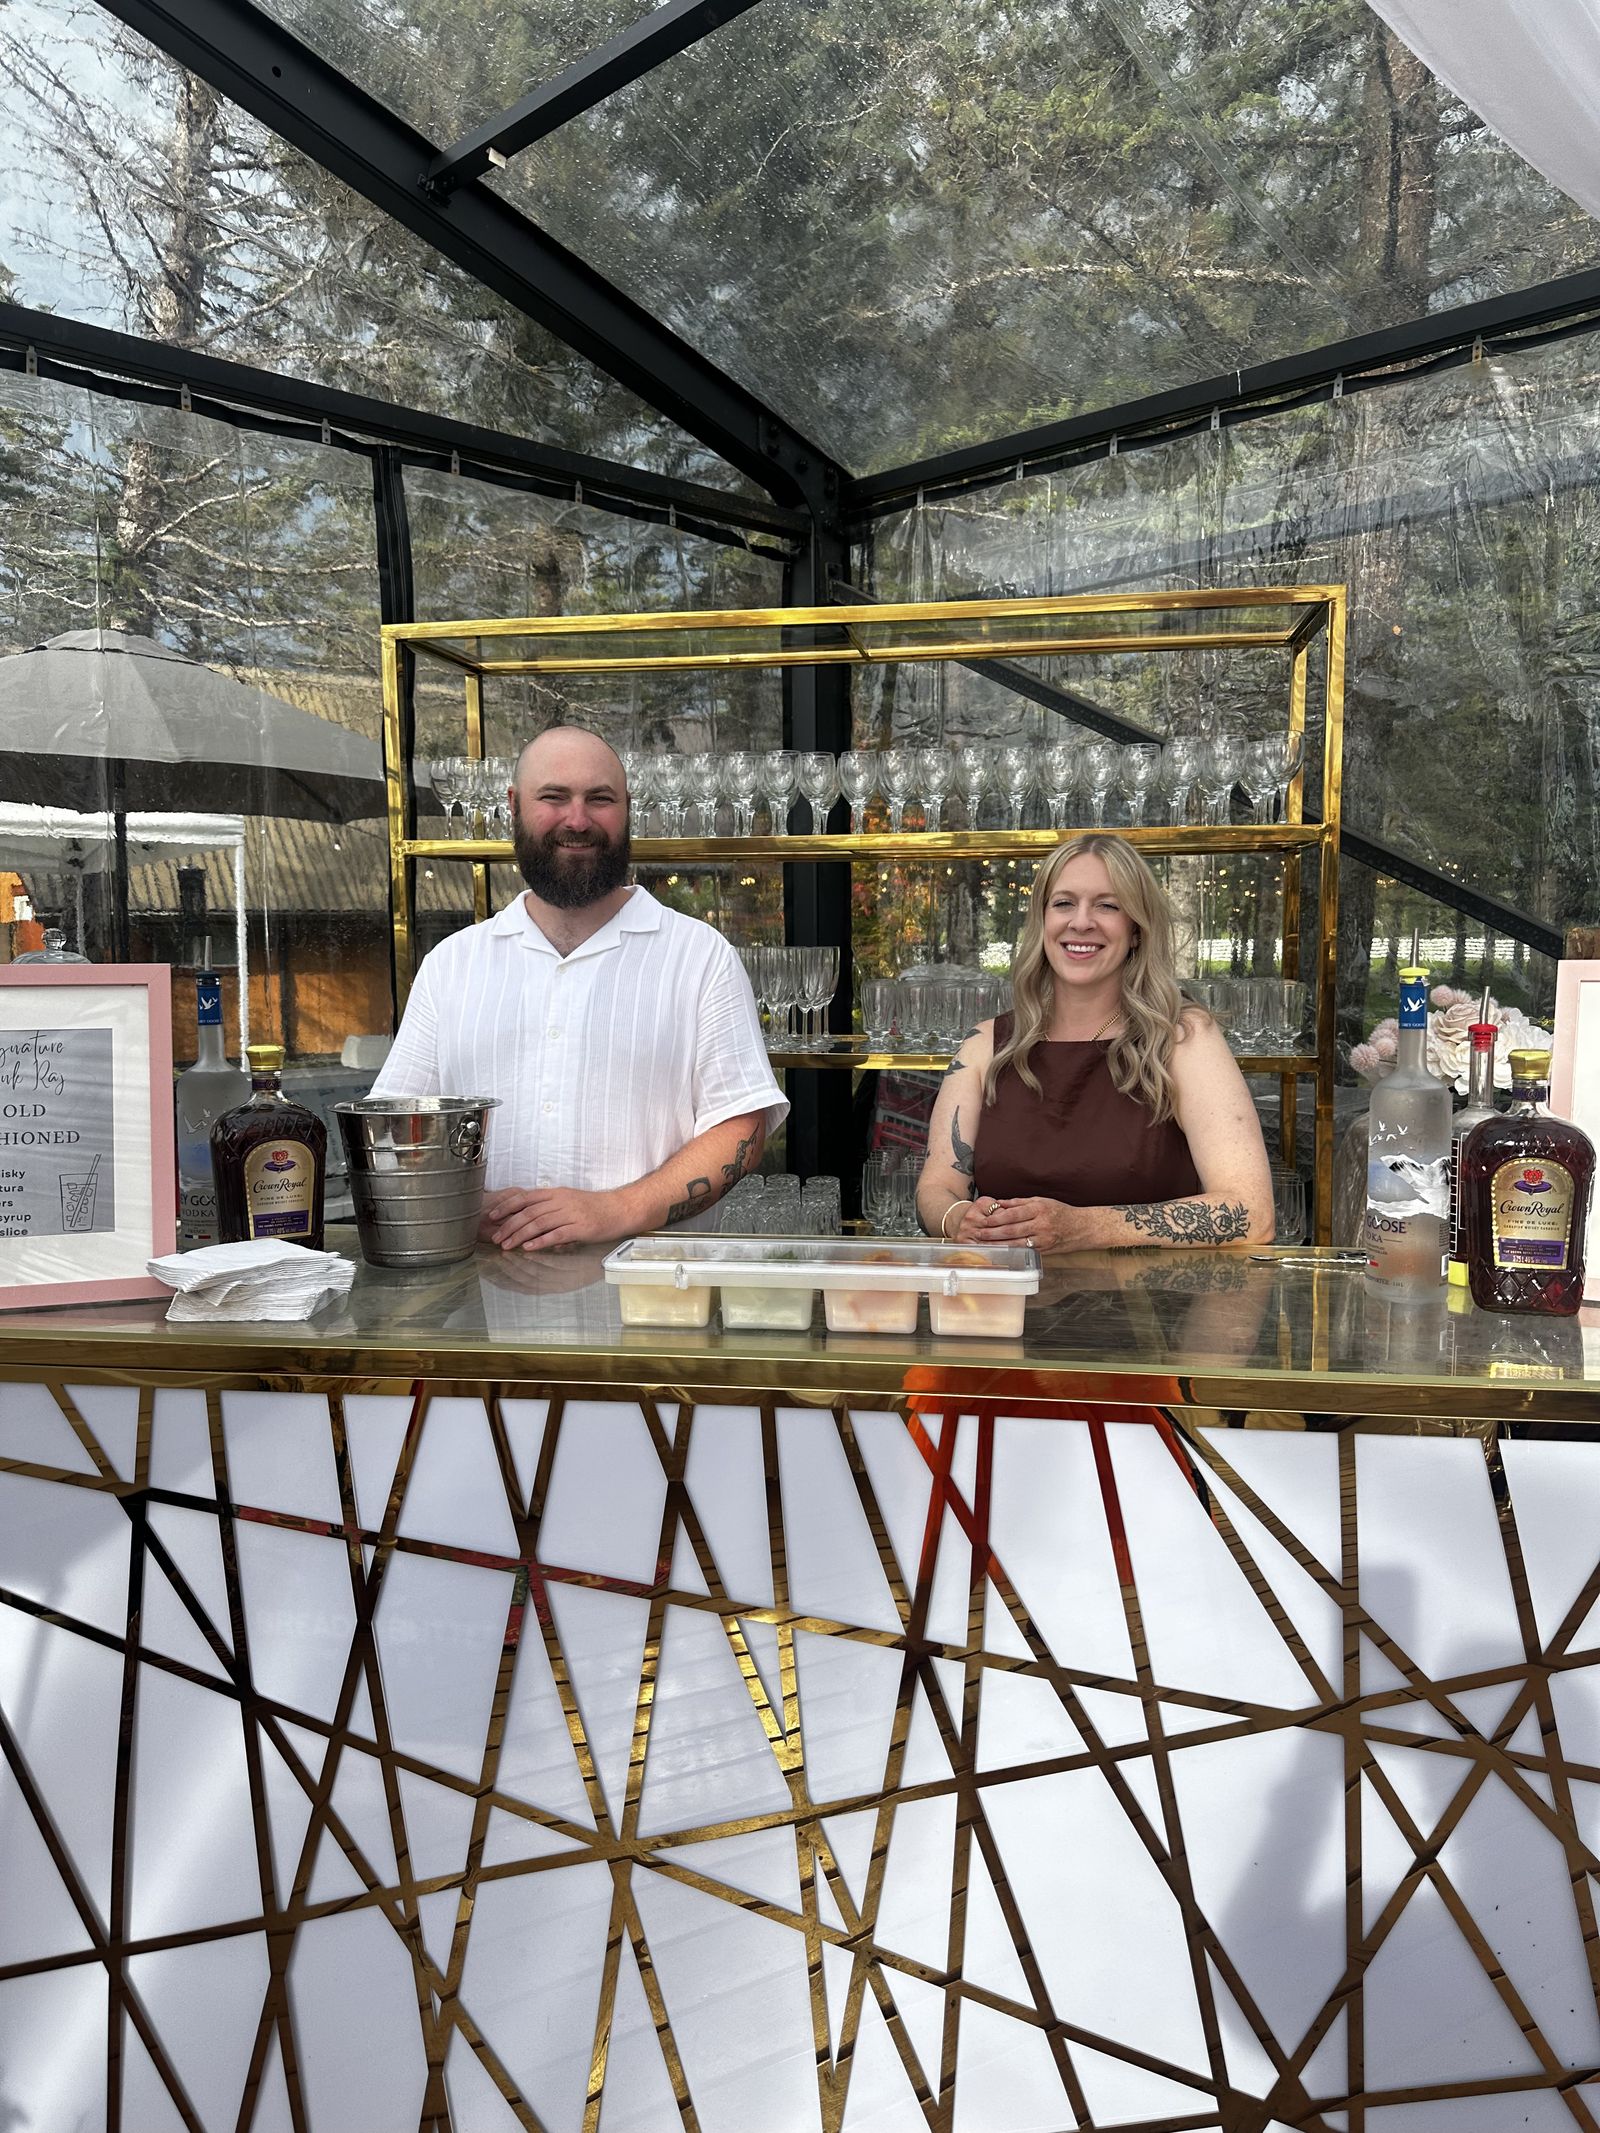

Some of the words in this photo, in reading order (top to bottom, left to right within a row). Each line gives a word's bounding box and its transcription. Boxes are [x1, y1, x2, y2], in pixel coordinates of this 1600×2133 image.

[3, 1104, 46, 1118] OLD
[253, 1179, 280, 1193] Crown
[276, 1177, 308, 1192] Royal
[0, 1200, 14, 1208] rs
[1500, 1200, 1531, 1215] Crown
[1526, 1201, 1565, 1217] Royal
[0, 1227, 28, 1236] slice
[1367, 1215, 1407, 1234] GOOSE
